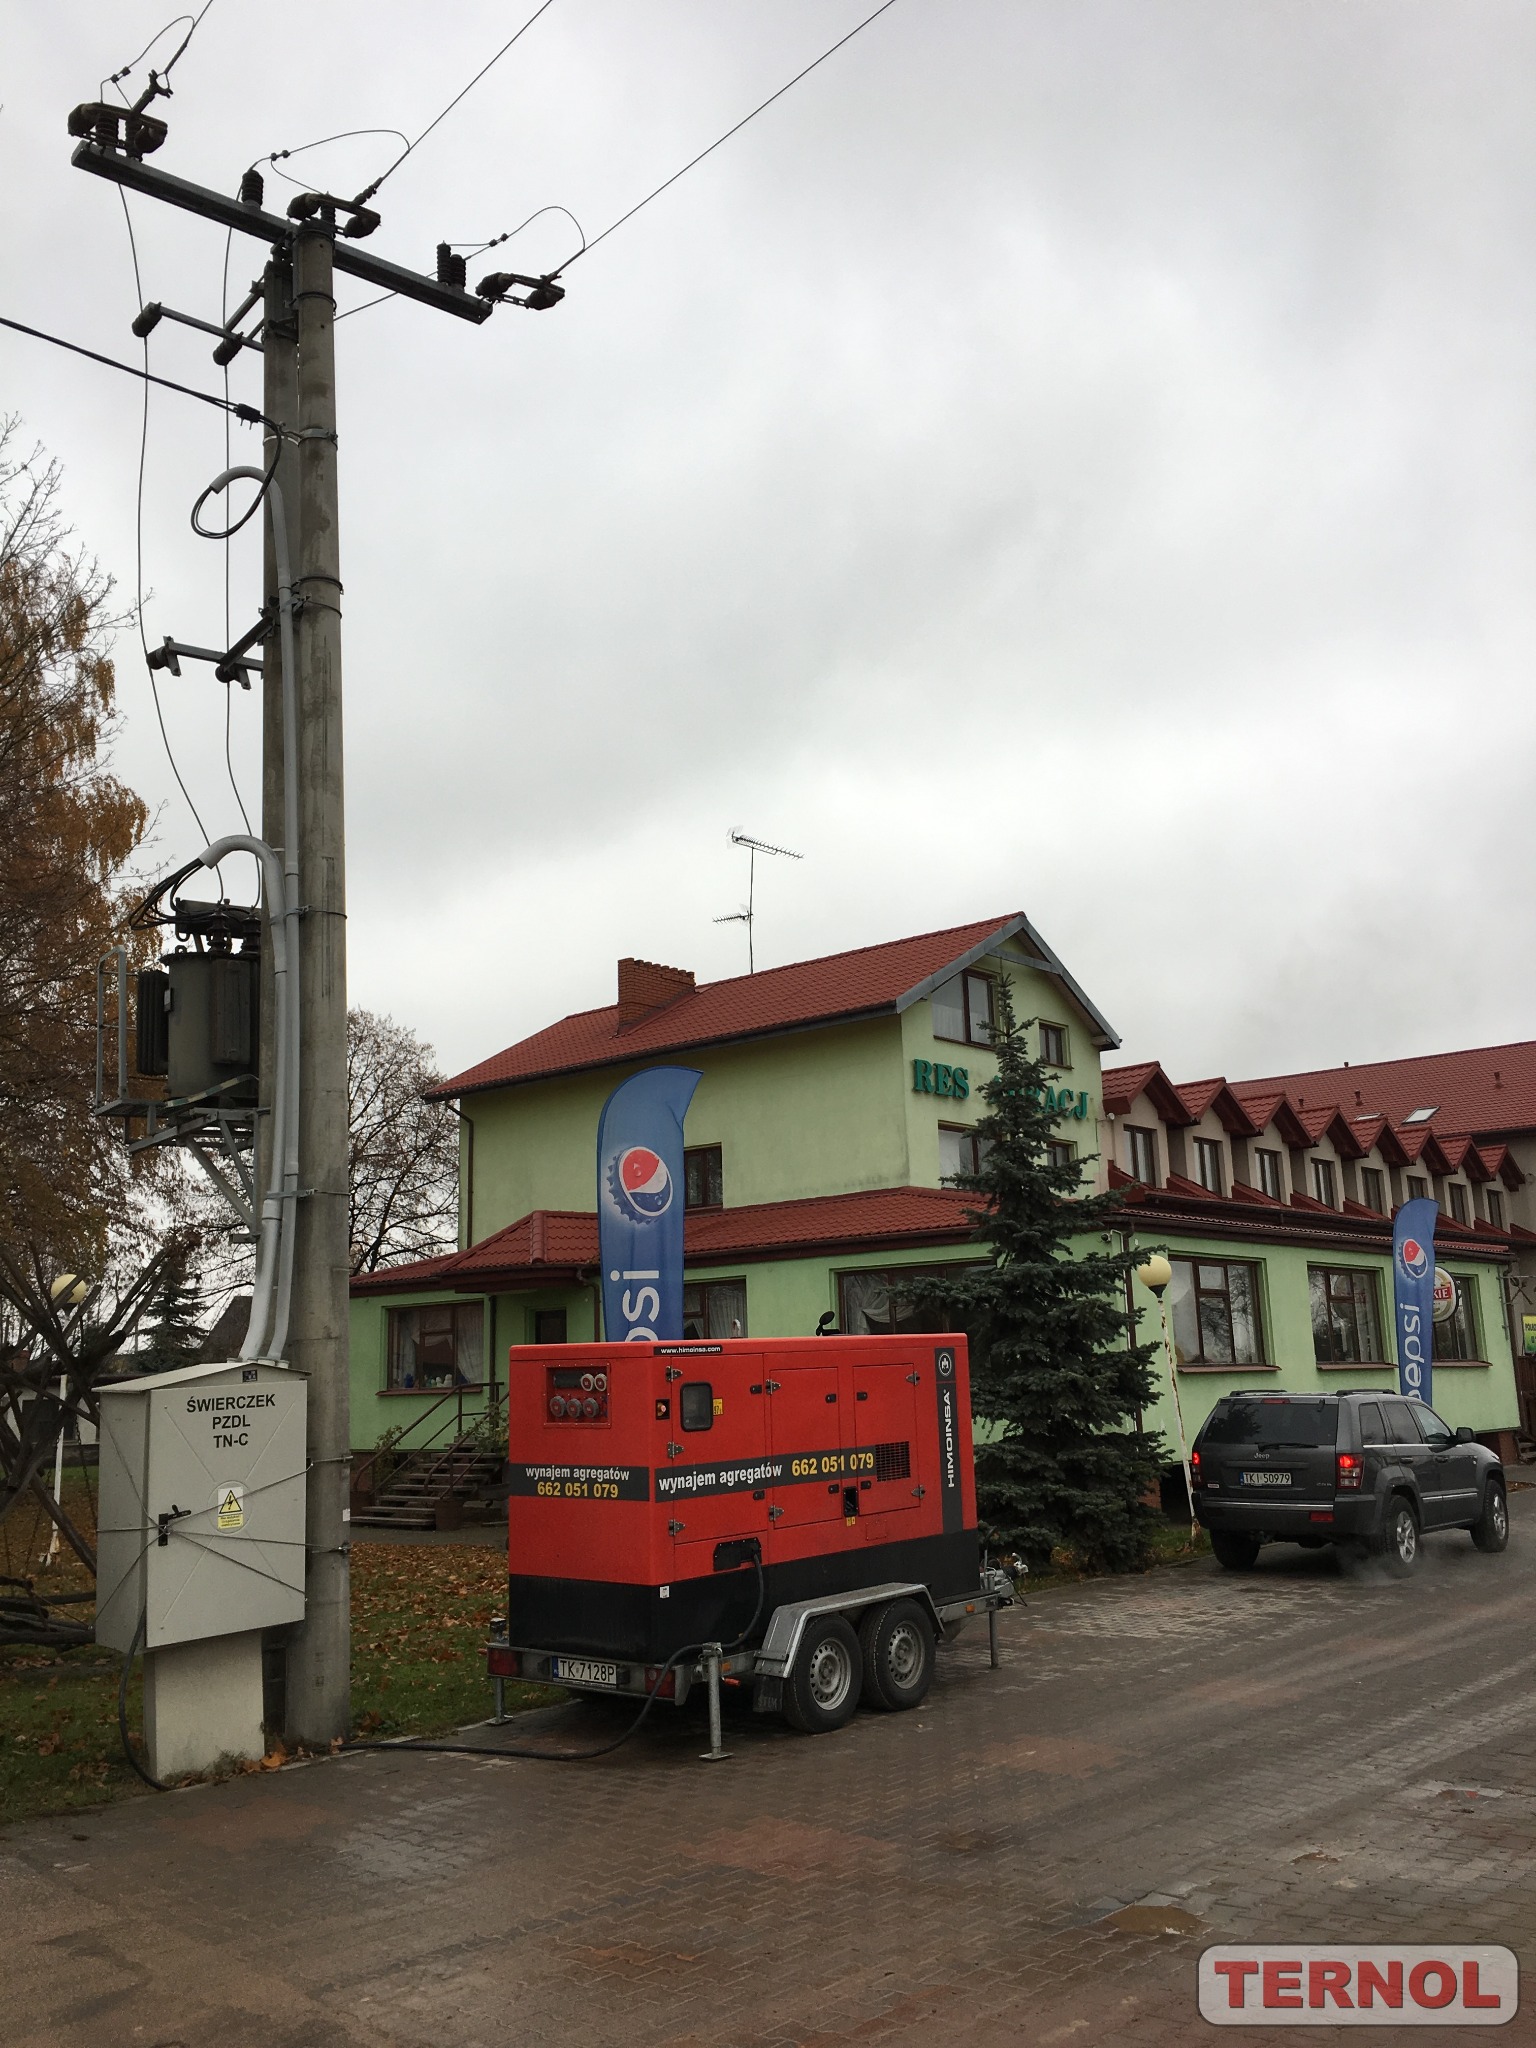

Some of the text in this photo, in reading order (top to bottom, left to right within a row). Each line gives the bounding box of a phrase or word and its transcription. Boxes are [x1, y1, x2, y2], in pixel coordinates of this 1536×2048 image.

[660, 1346, 721, 1354] www.himoinsa.com
[186, 1393, 276, 1413] ŚWIERCZEK
[212, 1415, 251, 1430] PZDL
[213, 1433, 249, 1448] TN-C
[944, 1392, 956, 1488] HIMOINSA
[525, 1466, 630, 1482] wynajem agregatów
[659, 1453, 874, 1494] wynajem agregatów 662 051 079
[1244, 1473, 1290, 1483] TKI 50979
[537, 1482, 619, 1498] 662 051 079
[560, 1660, 615, 1681] TK 7128P
